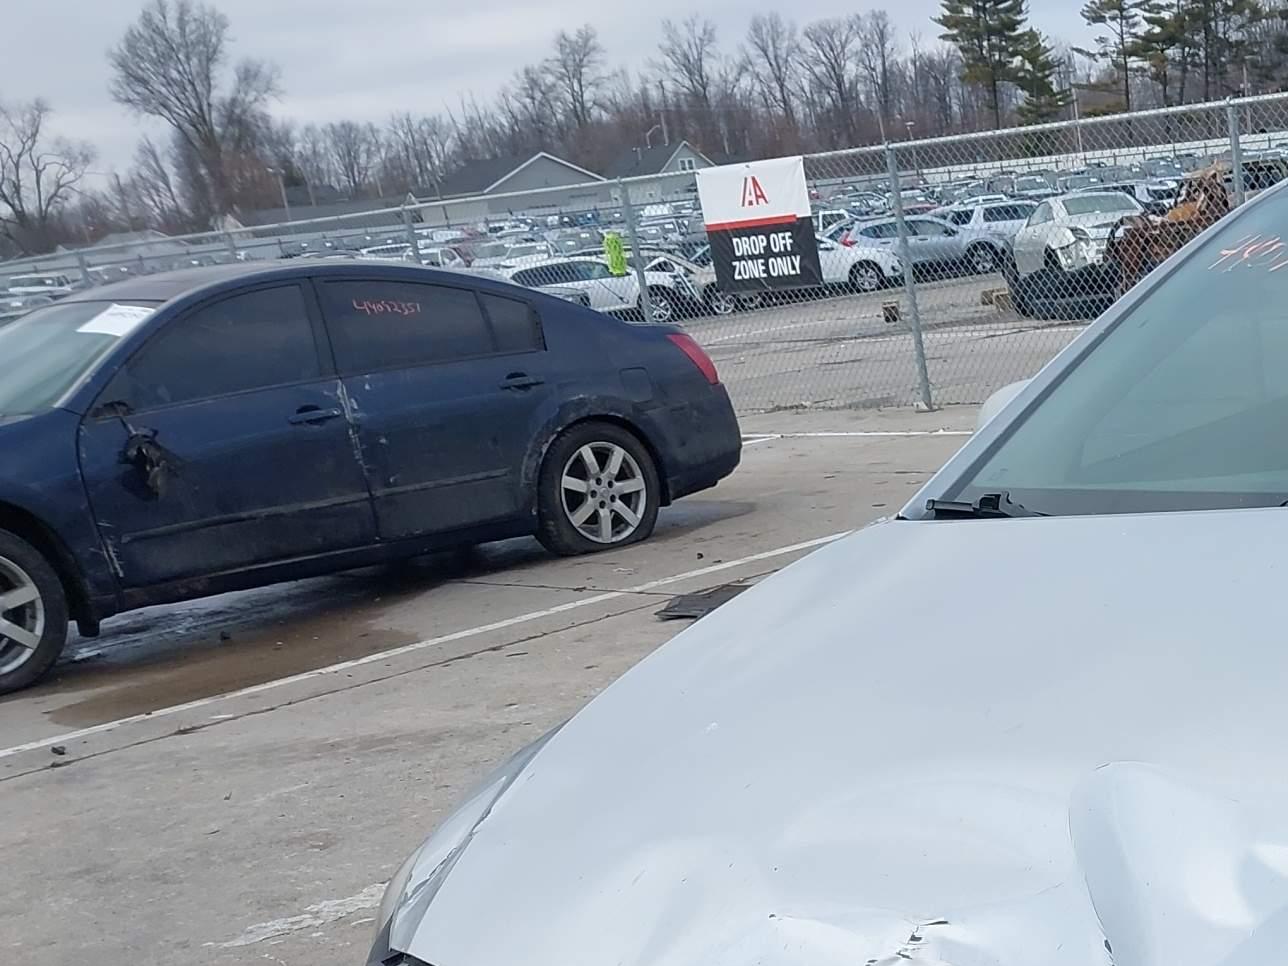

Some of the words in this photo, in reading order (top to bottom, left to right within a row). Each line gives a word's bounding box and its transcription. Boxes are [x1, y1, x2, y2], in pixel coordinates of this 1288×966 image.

[732, 234, 768, 257] DROP
[769, 231, 794, 253] OFF
[732, 258, 766, 280] ZONE
[768, 255, 801, 277] ONLY
